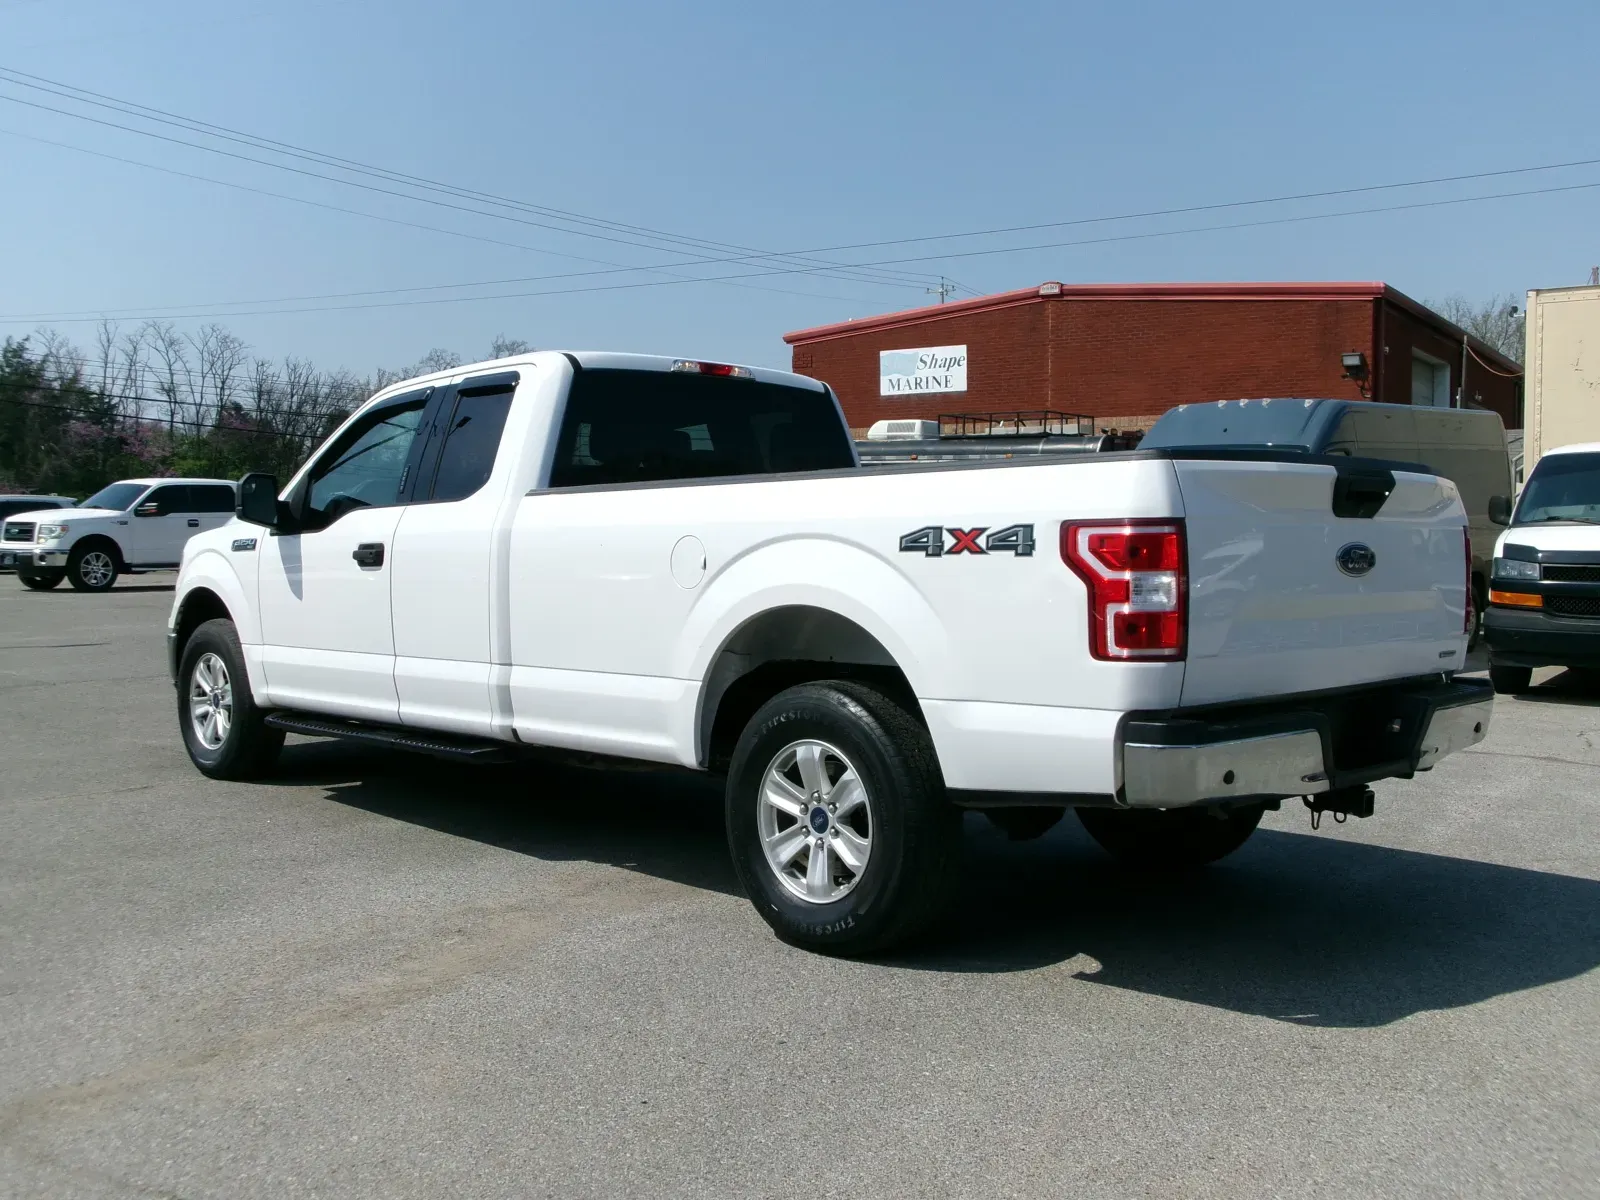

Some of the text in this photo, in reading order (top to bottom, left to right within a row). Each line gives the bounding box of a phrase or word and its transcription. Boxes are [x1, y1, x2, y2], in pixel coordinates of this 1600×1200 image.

[916, 353, 966, 371] Shape
[888, 374, 954, 392] MARINE
[760, 707, 823, 734] Fireston
[790, 915, 856, 936] Firesto
